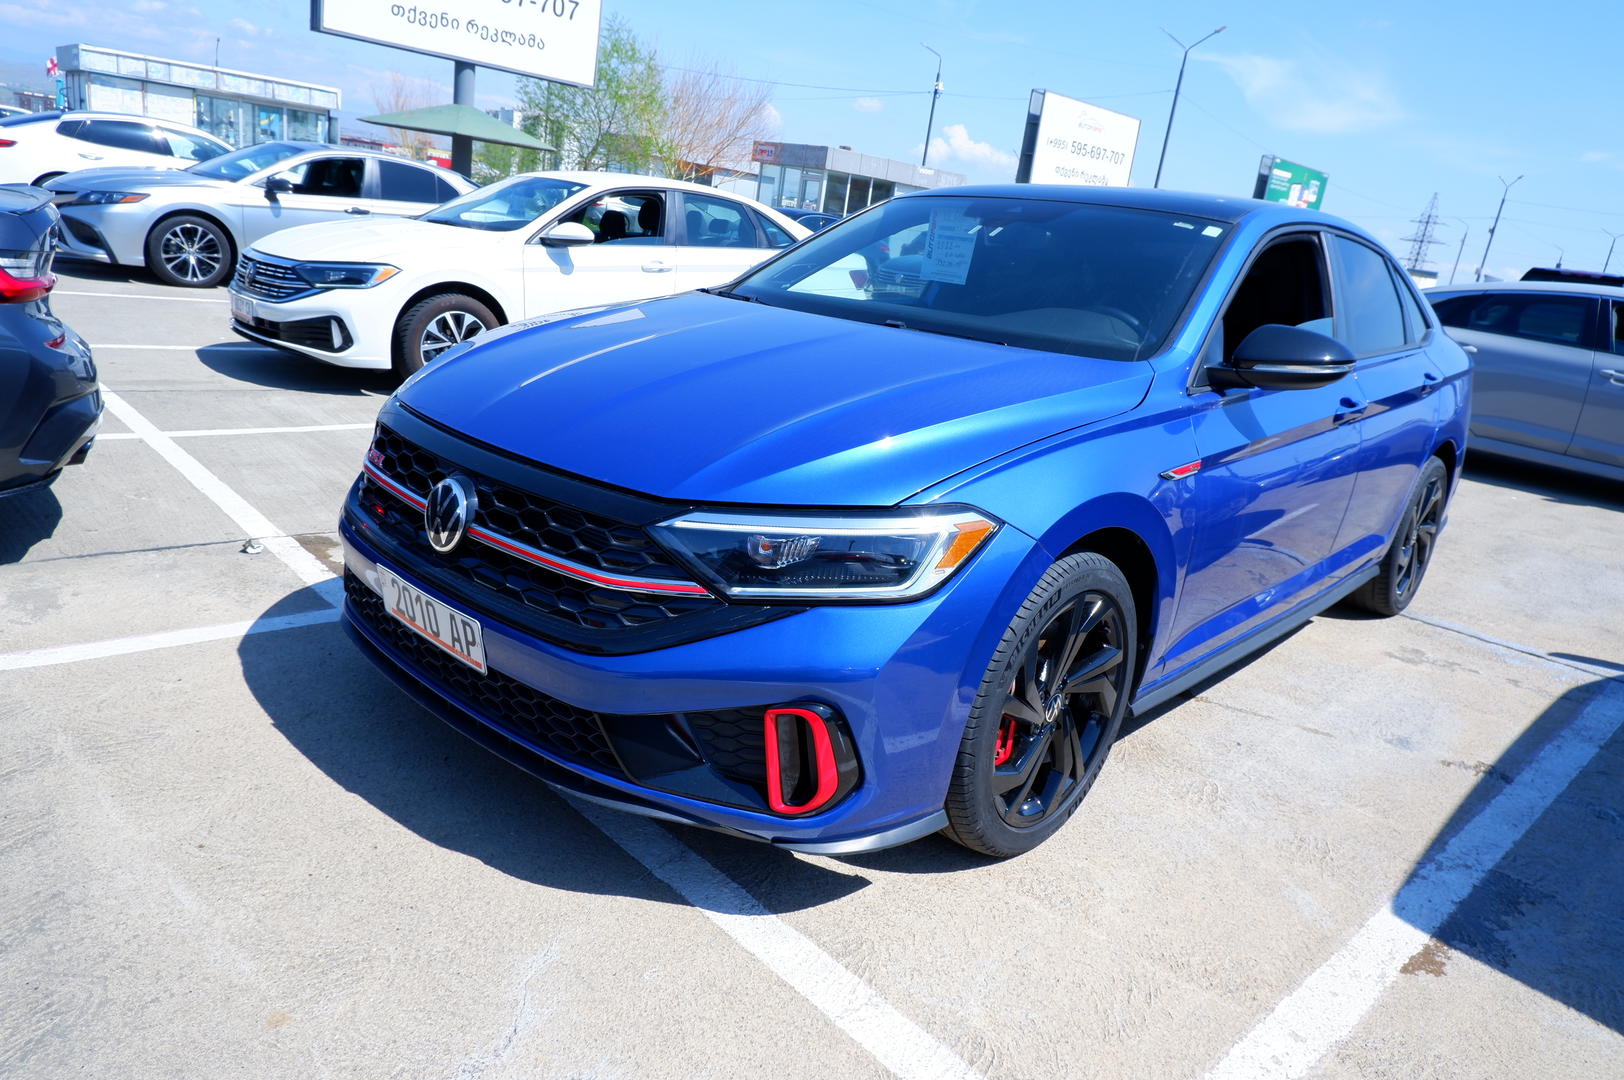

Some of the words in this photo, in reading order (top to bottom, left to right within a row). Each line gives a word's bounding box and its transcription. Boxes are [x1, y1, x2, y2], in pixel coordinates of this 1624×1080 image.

[391, 4, 460, 30] თქვენი
[466, 19, 545, 50] რეკლამა
[1070, 140, 1125, 165] 595-697-707
[391, 577, 441, 638] 2010
[449, 612, 477, 657] AP
